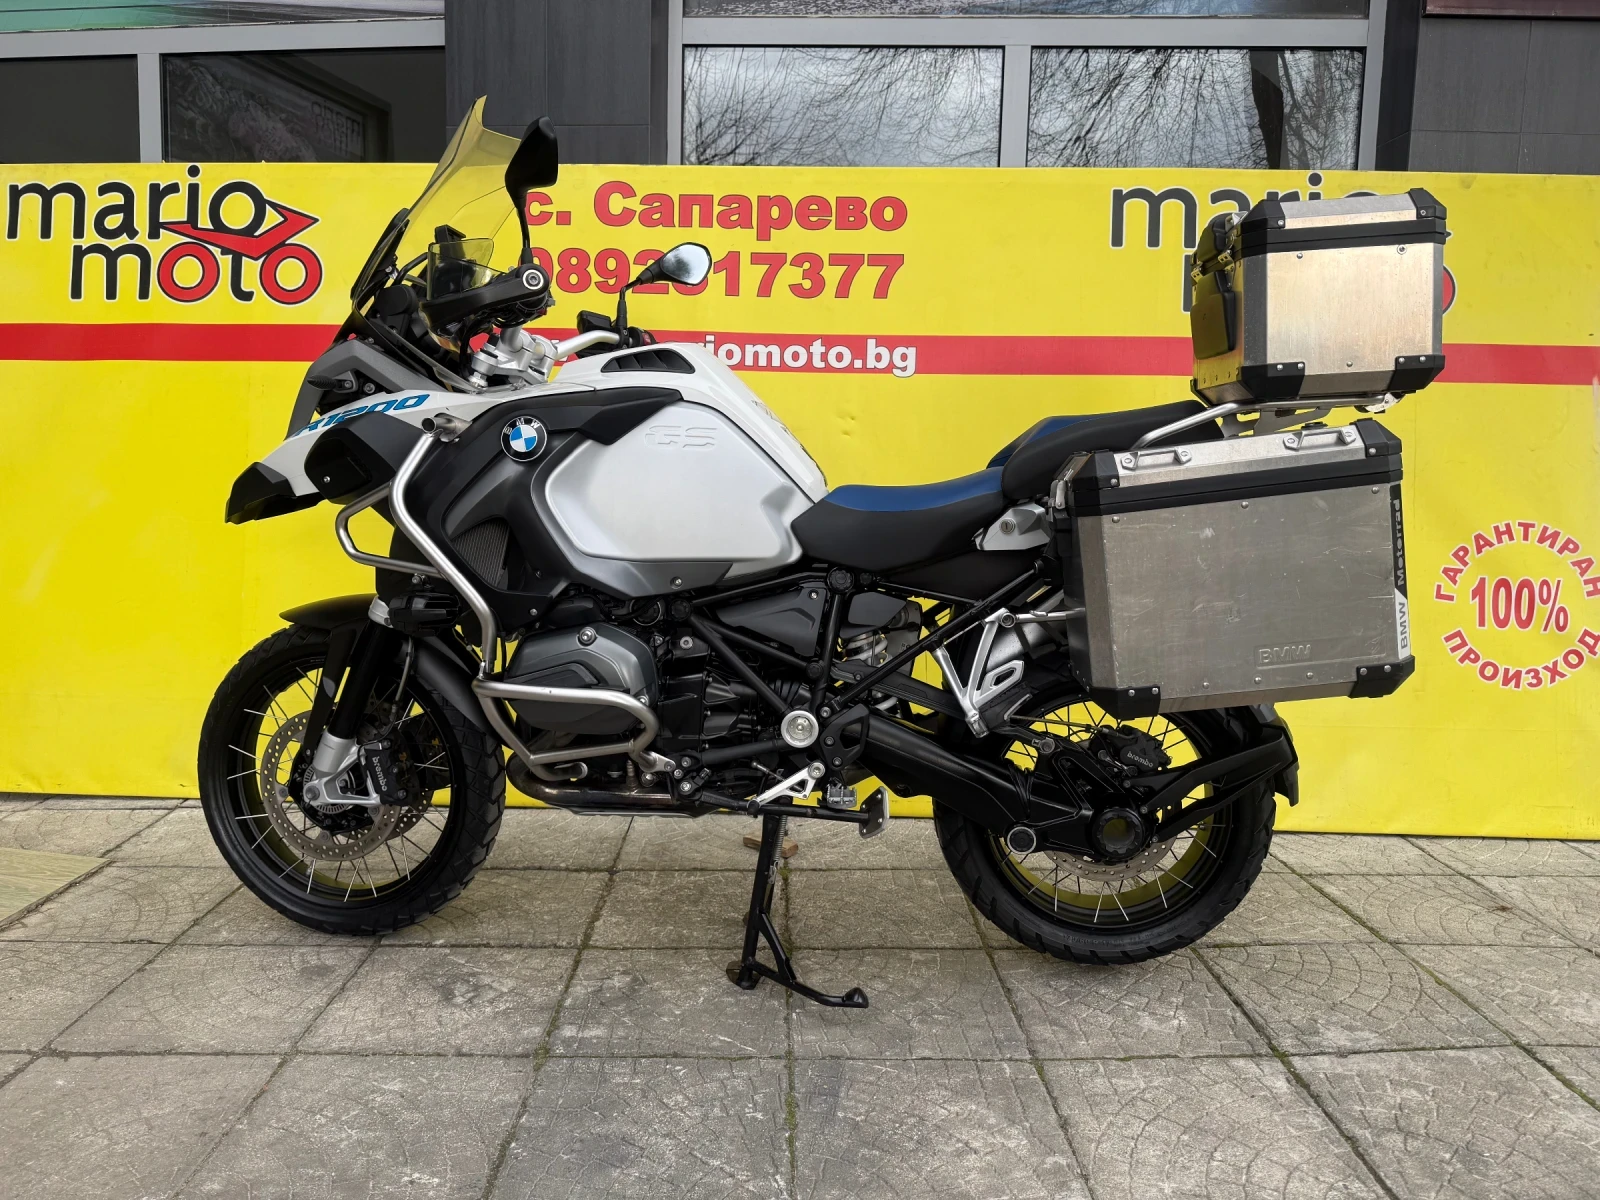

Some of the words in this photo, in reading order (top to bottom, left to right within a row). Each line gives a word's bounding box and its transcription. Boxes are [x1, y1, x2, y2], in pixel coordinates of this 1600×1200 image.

[6, 164, 267, 240] mario
[593, 180, 908, 241] Сапарево
[70, 242, 323, 305] moto
[518, 247, 905, 300] 89217377
[1434, 521, 1600, 603] ГАРАНТИРАН
[1398, 602, 1409, 650] BMW
[1471, 577, 1569, 632] 100%
[1258, 644, 1312, 664] BMW
[1443, 628, 1600, 690] ПРОИЗХОД
[372, 755, 388, 792] brembo
[1126, 750, 1154, 768] brembo
